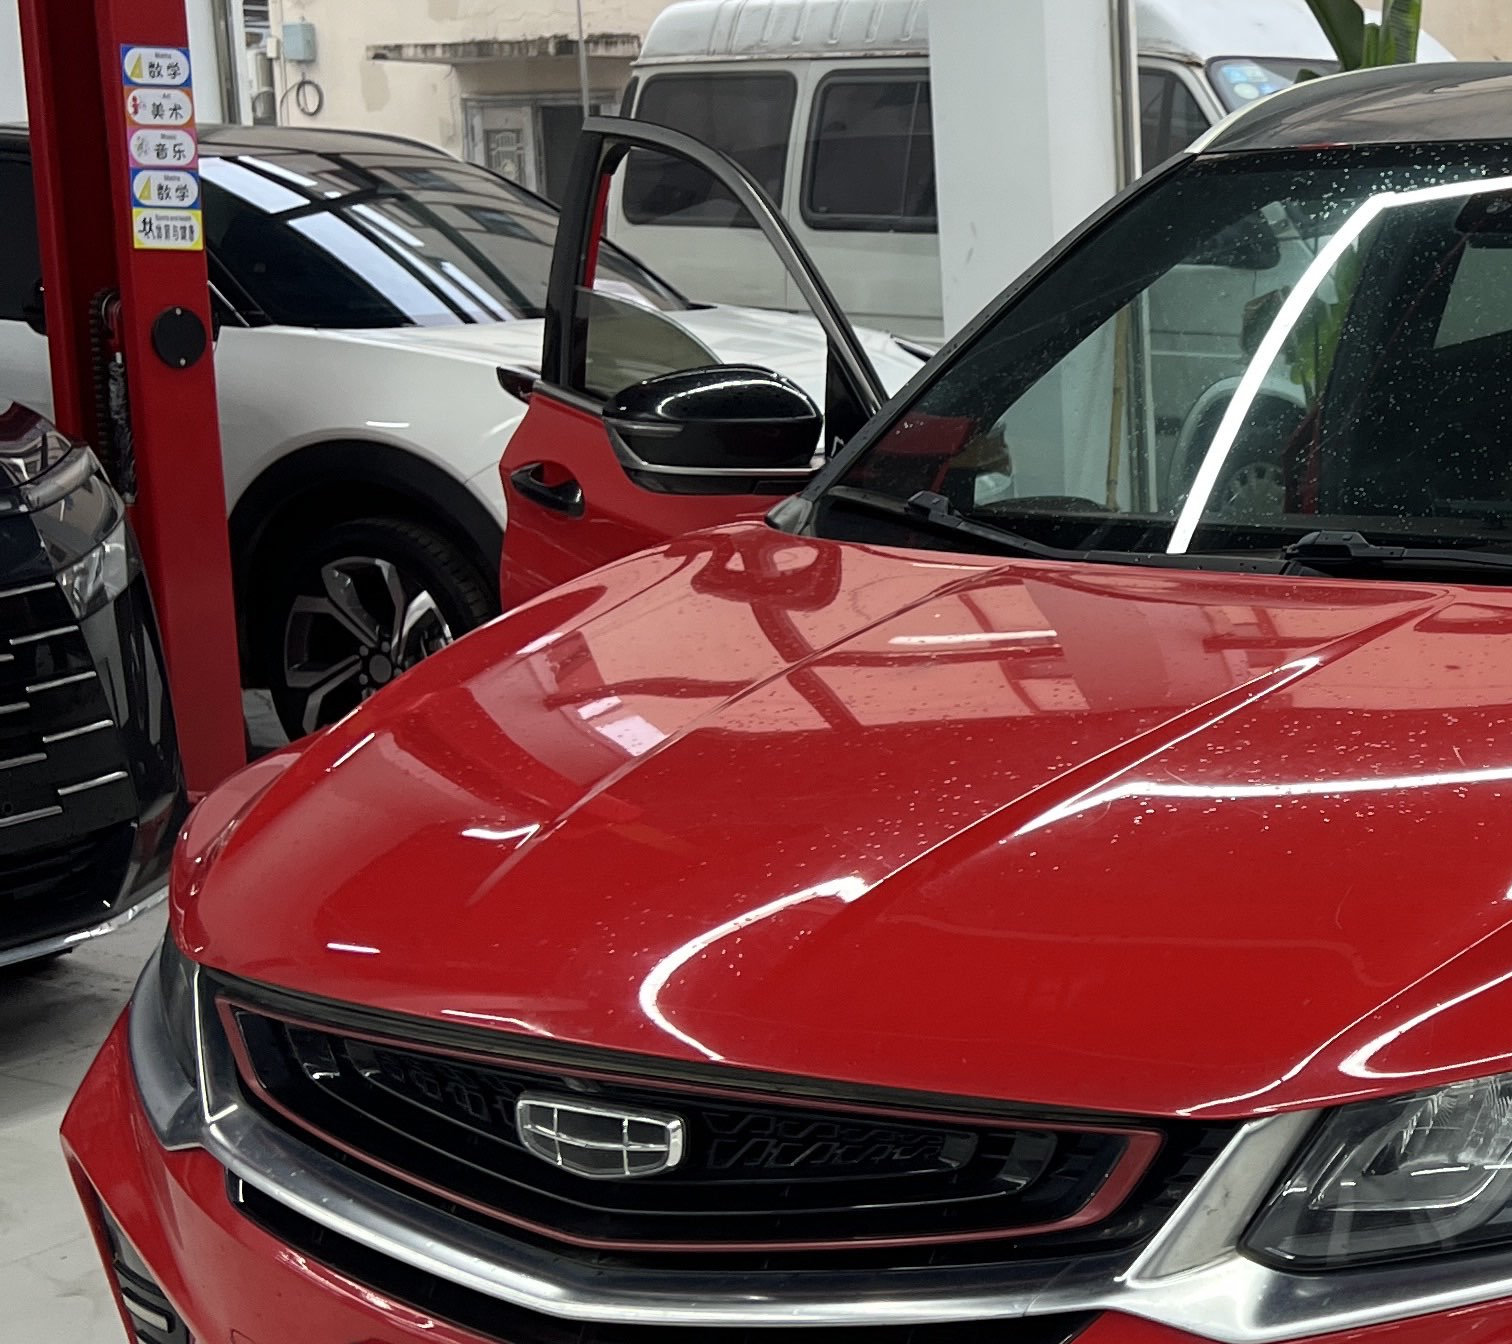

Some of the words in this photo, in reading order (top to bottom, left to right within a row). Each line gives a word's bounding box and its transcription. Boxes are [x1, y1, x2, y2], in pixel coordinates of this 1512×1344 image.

[148, 61, 181, 79] 数学
[151, 101, 184, 120] 美术
[154, 143, 187, 161] 音乐
[157, 183, 190, 201] 数学
